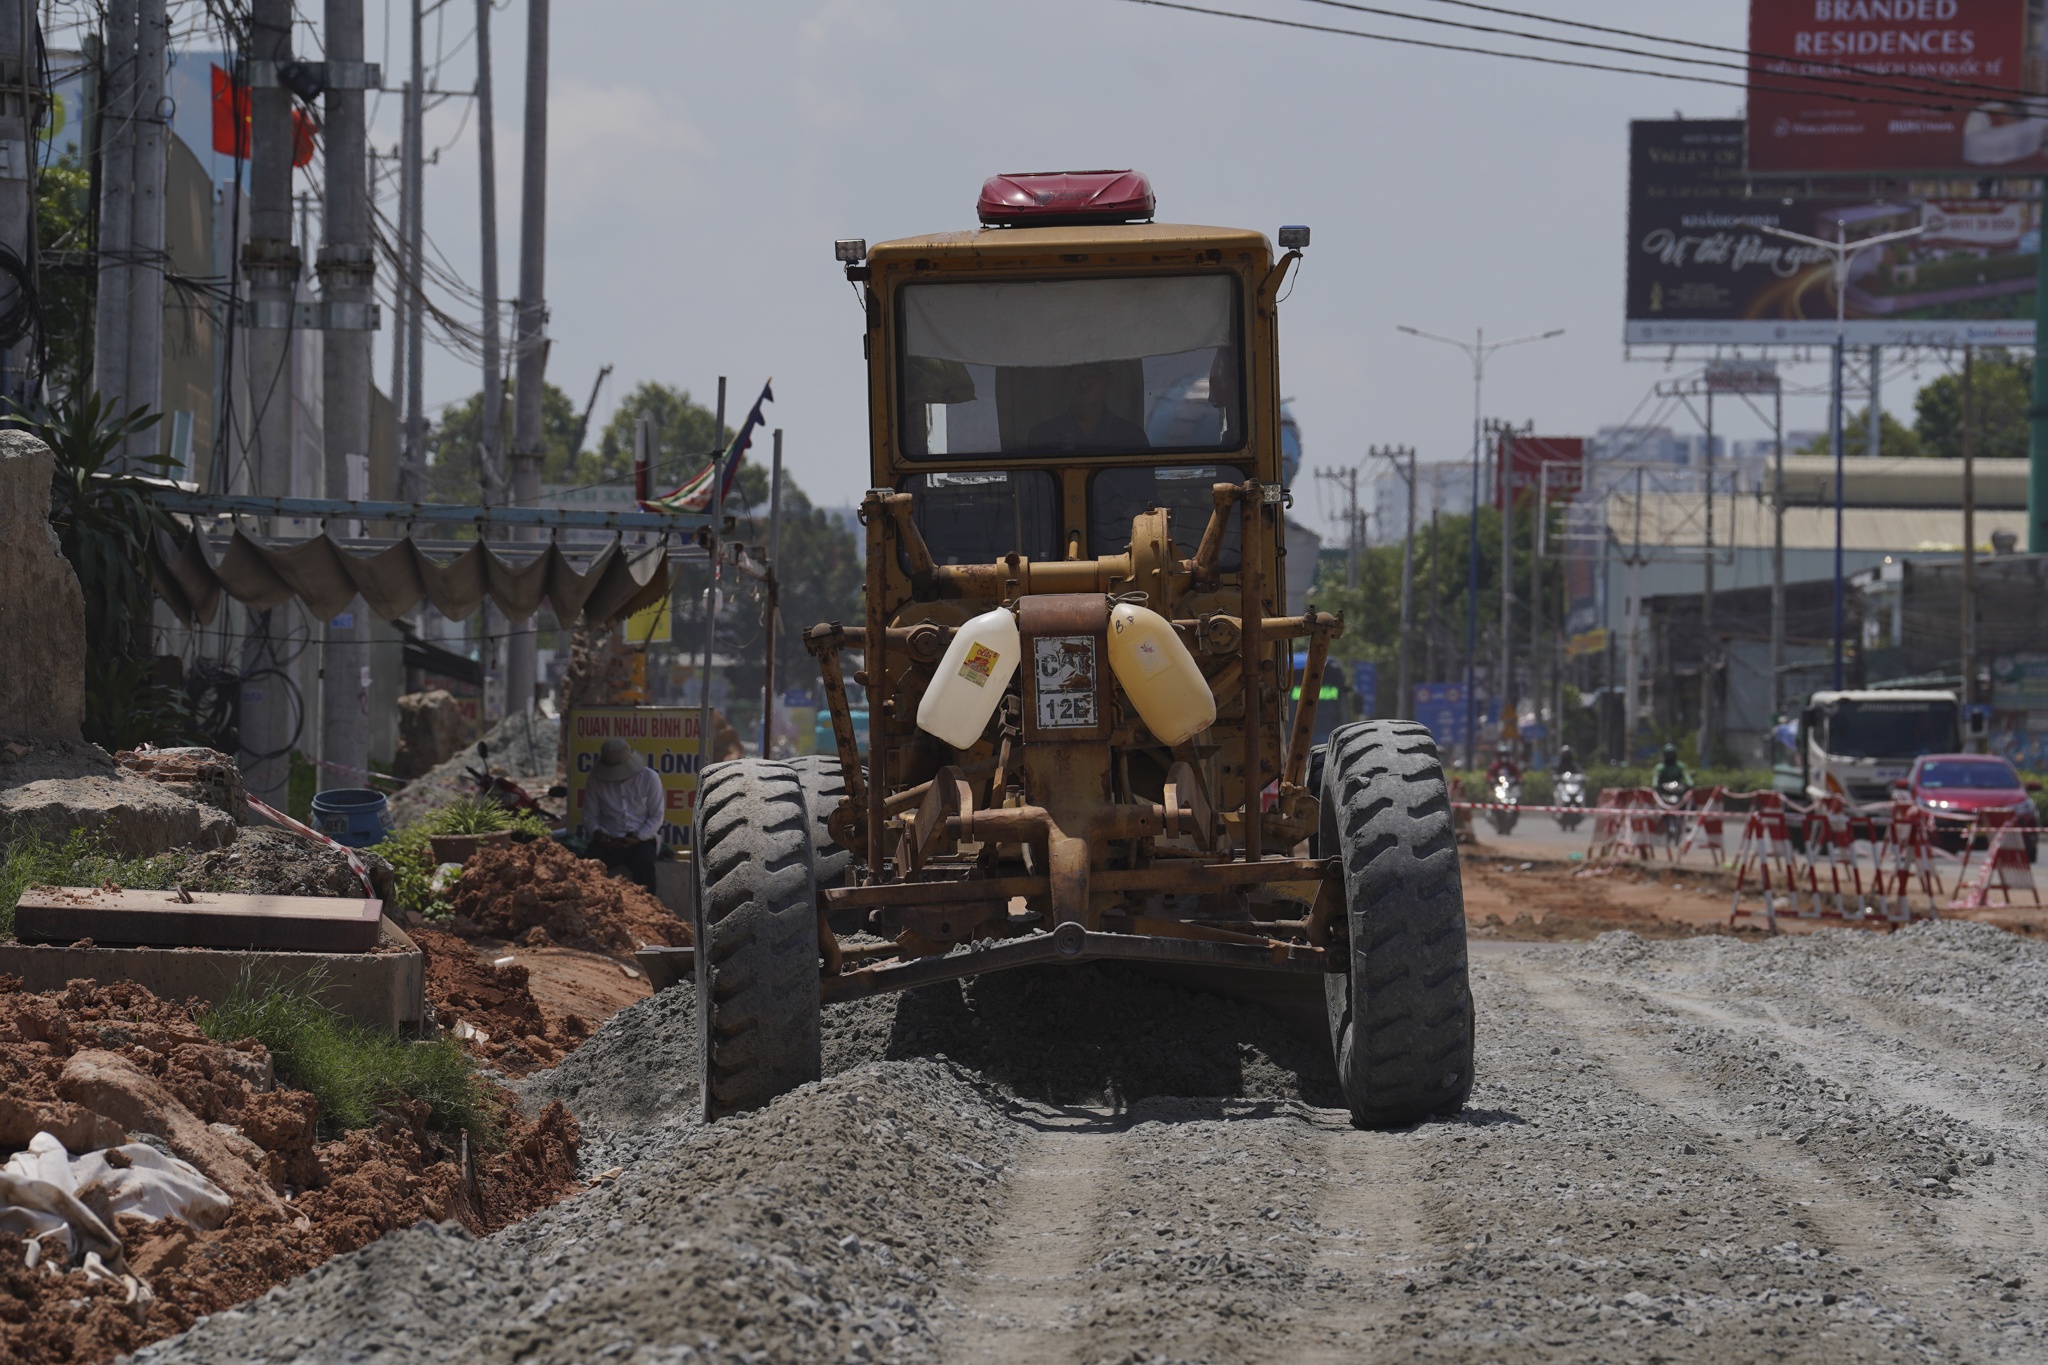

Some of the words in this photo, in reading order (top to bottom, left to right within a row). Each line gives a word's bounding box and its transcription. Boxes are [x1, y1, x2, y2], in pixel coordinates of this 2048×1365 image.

[1815, 0, 1958, 20] BRANDED
[1795, 30, 1976, 54] RESIDENCES
[614, 713, 647, 742] NHẬU
[651, 713, 681, 738] BÌNH
